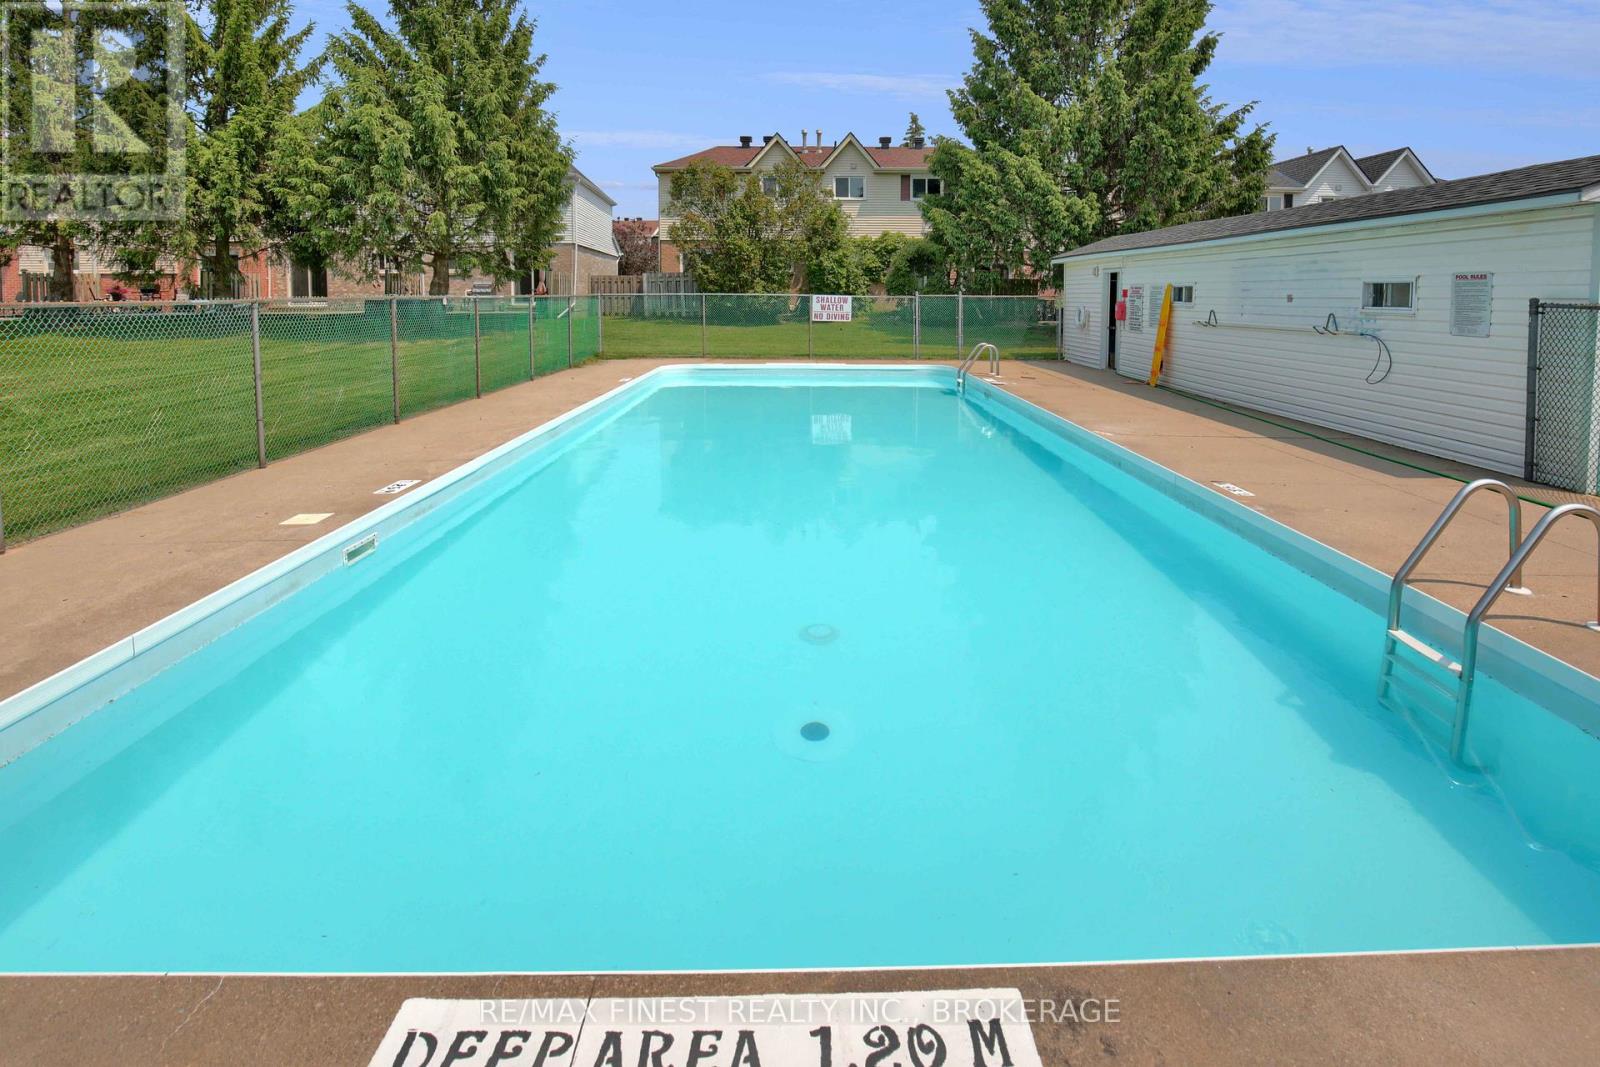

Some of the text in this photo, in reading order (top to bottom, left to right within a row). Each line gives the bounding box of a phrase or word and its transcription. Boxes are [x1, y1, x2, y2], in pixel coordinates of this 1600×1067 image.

[815, 296, 849, 304] SHALLOW
[820, 303, 844, 311] WATER
[592, 1029, 761, 1067] AREA
[967, 1017, 1014, 1067] M
